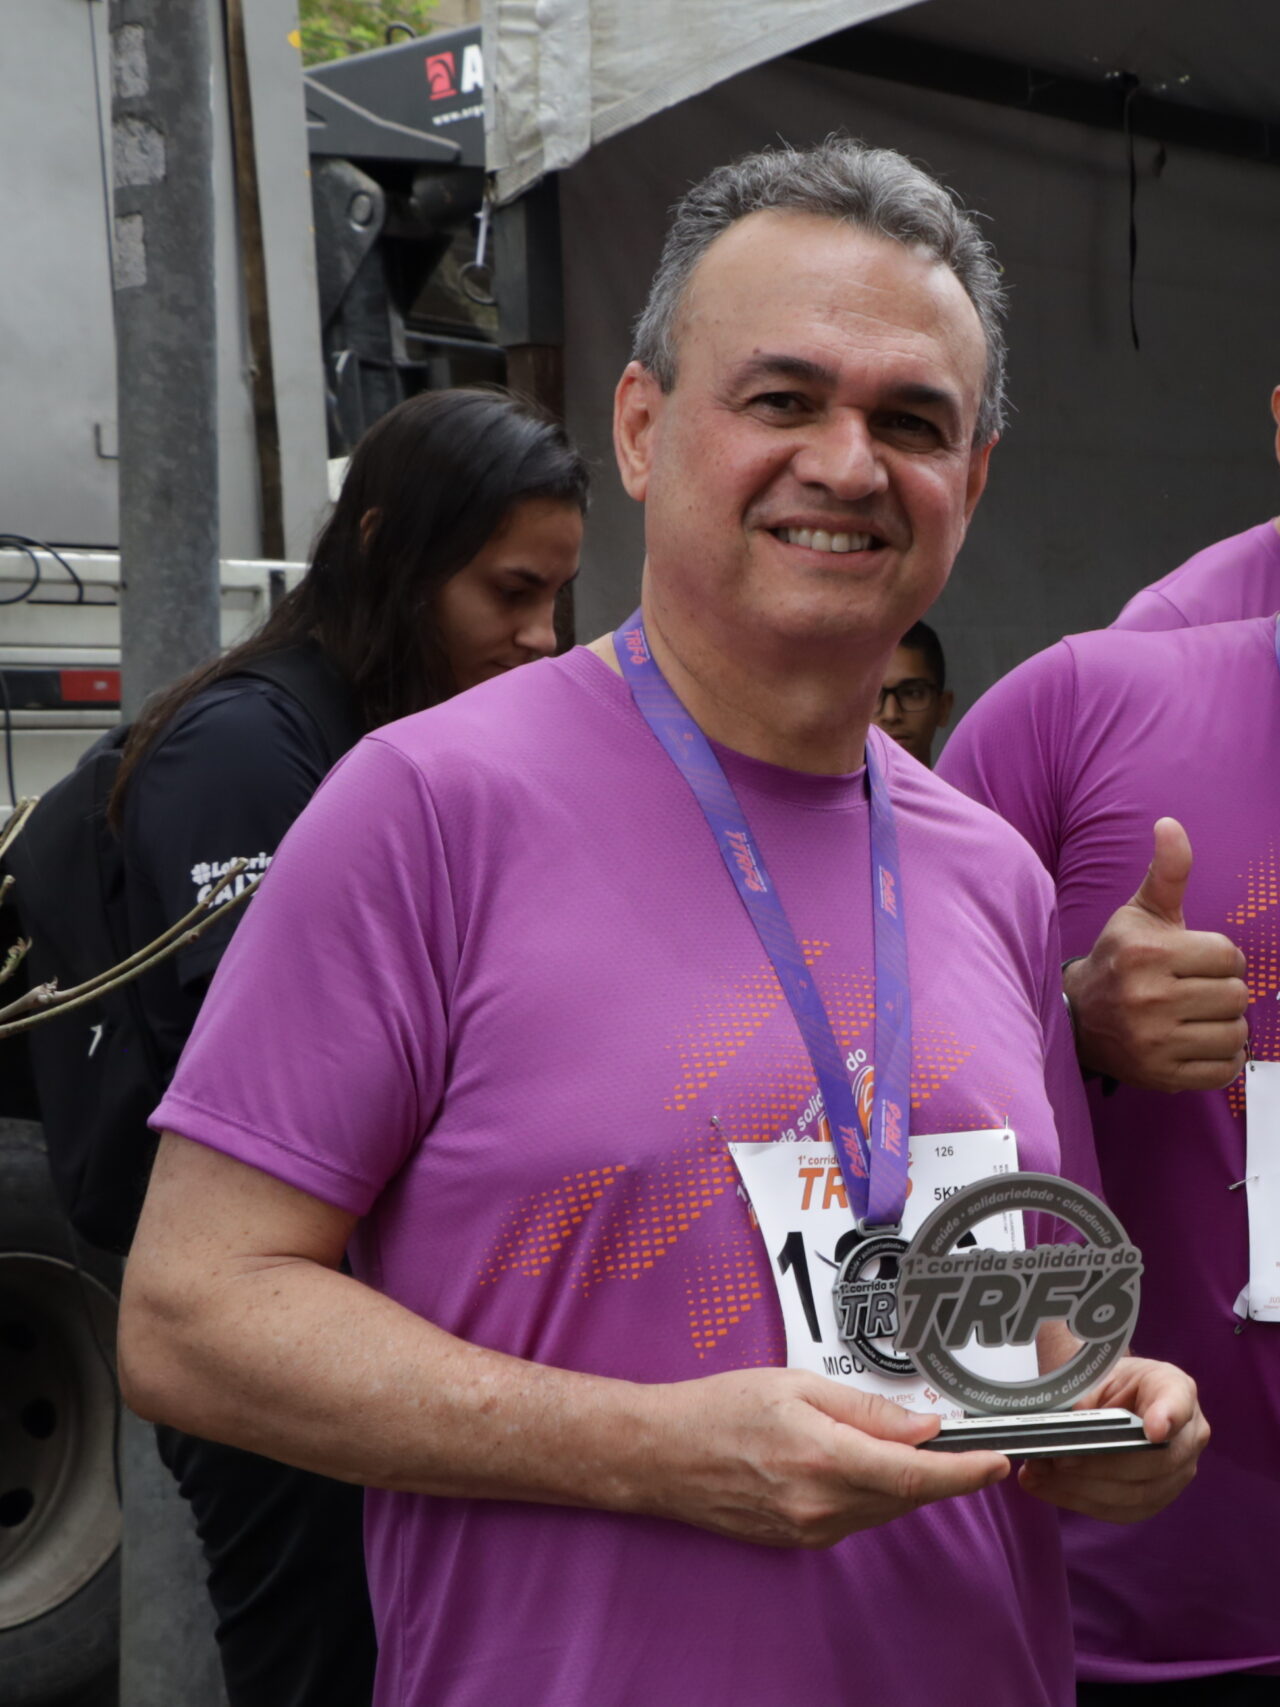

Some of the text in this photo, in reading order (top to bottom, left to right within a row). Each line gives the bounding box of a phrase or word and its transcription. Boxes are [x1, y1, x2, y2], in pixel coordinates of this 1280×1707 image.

[624, 629, 649, 665] TRF6
[846, 1048, 867, 1072] do
[935, 1146, 954, 1157] 126
[931, 1217, 960, 1253] saúde
[966, 1187, 1054, 1217] solidariedade
[1062, 1198, 1112, 1245] cidadania
[927, 1255, 1007, 1274] corrida
[1012, 1250, 1106, 1270] solidária
[1111, 1248, 1138, 1265] do
[850, 1280, 887, 1292] corrida
[899, 1266, 1140, 1349] TRF6
[926, 1342, 1112, 1409] saúde solidariedade cidadania
